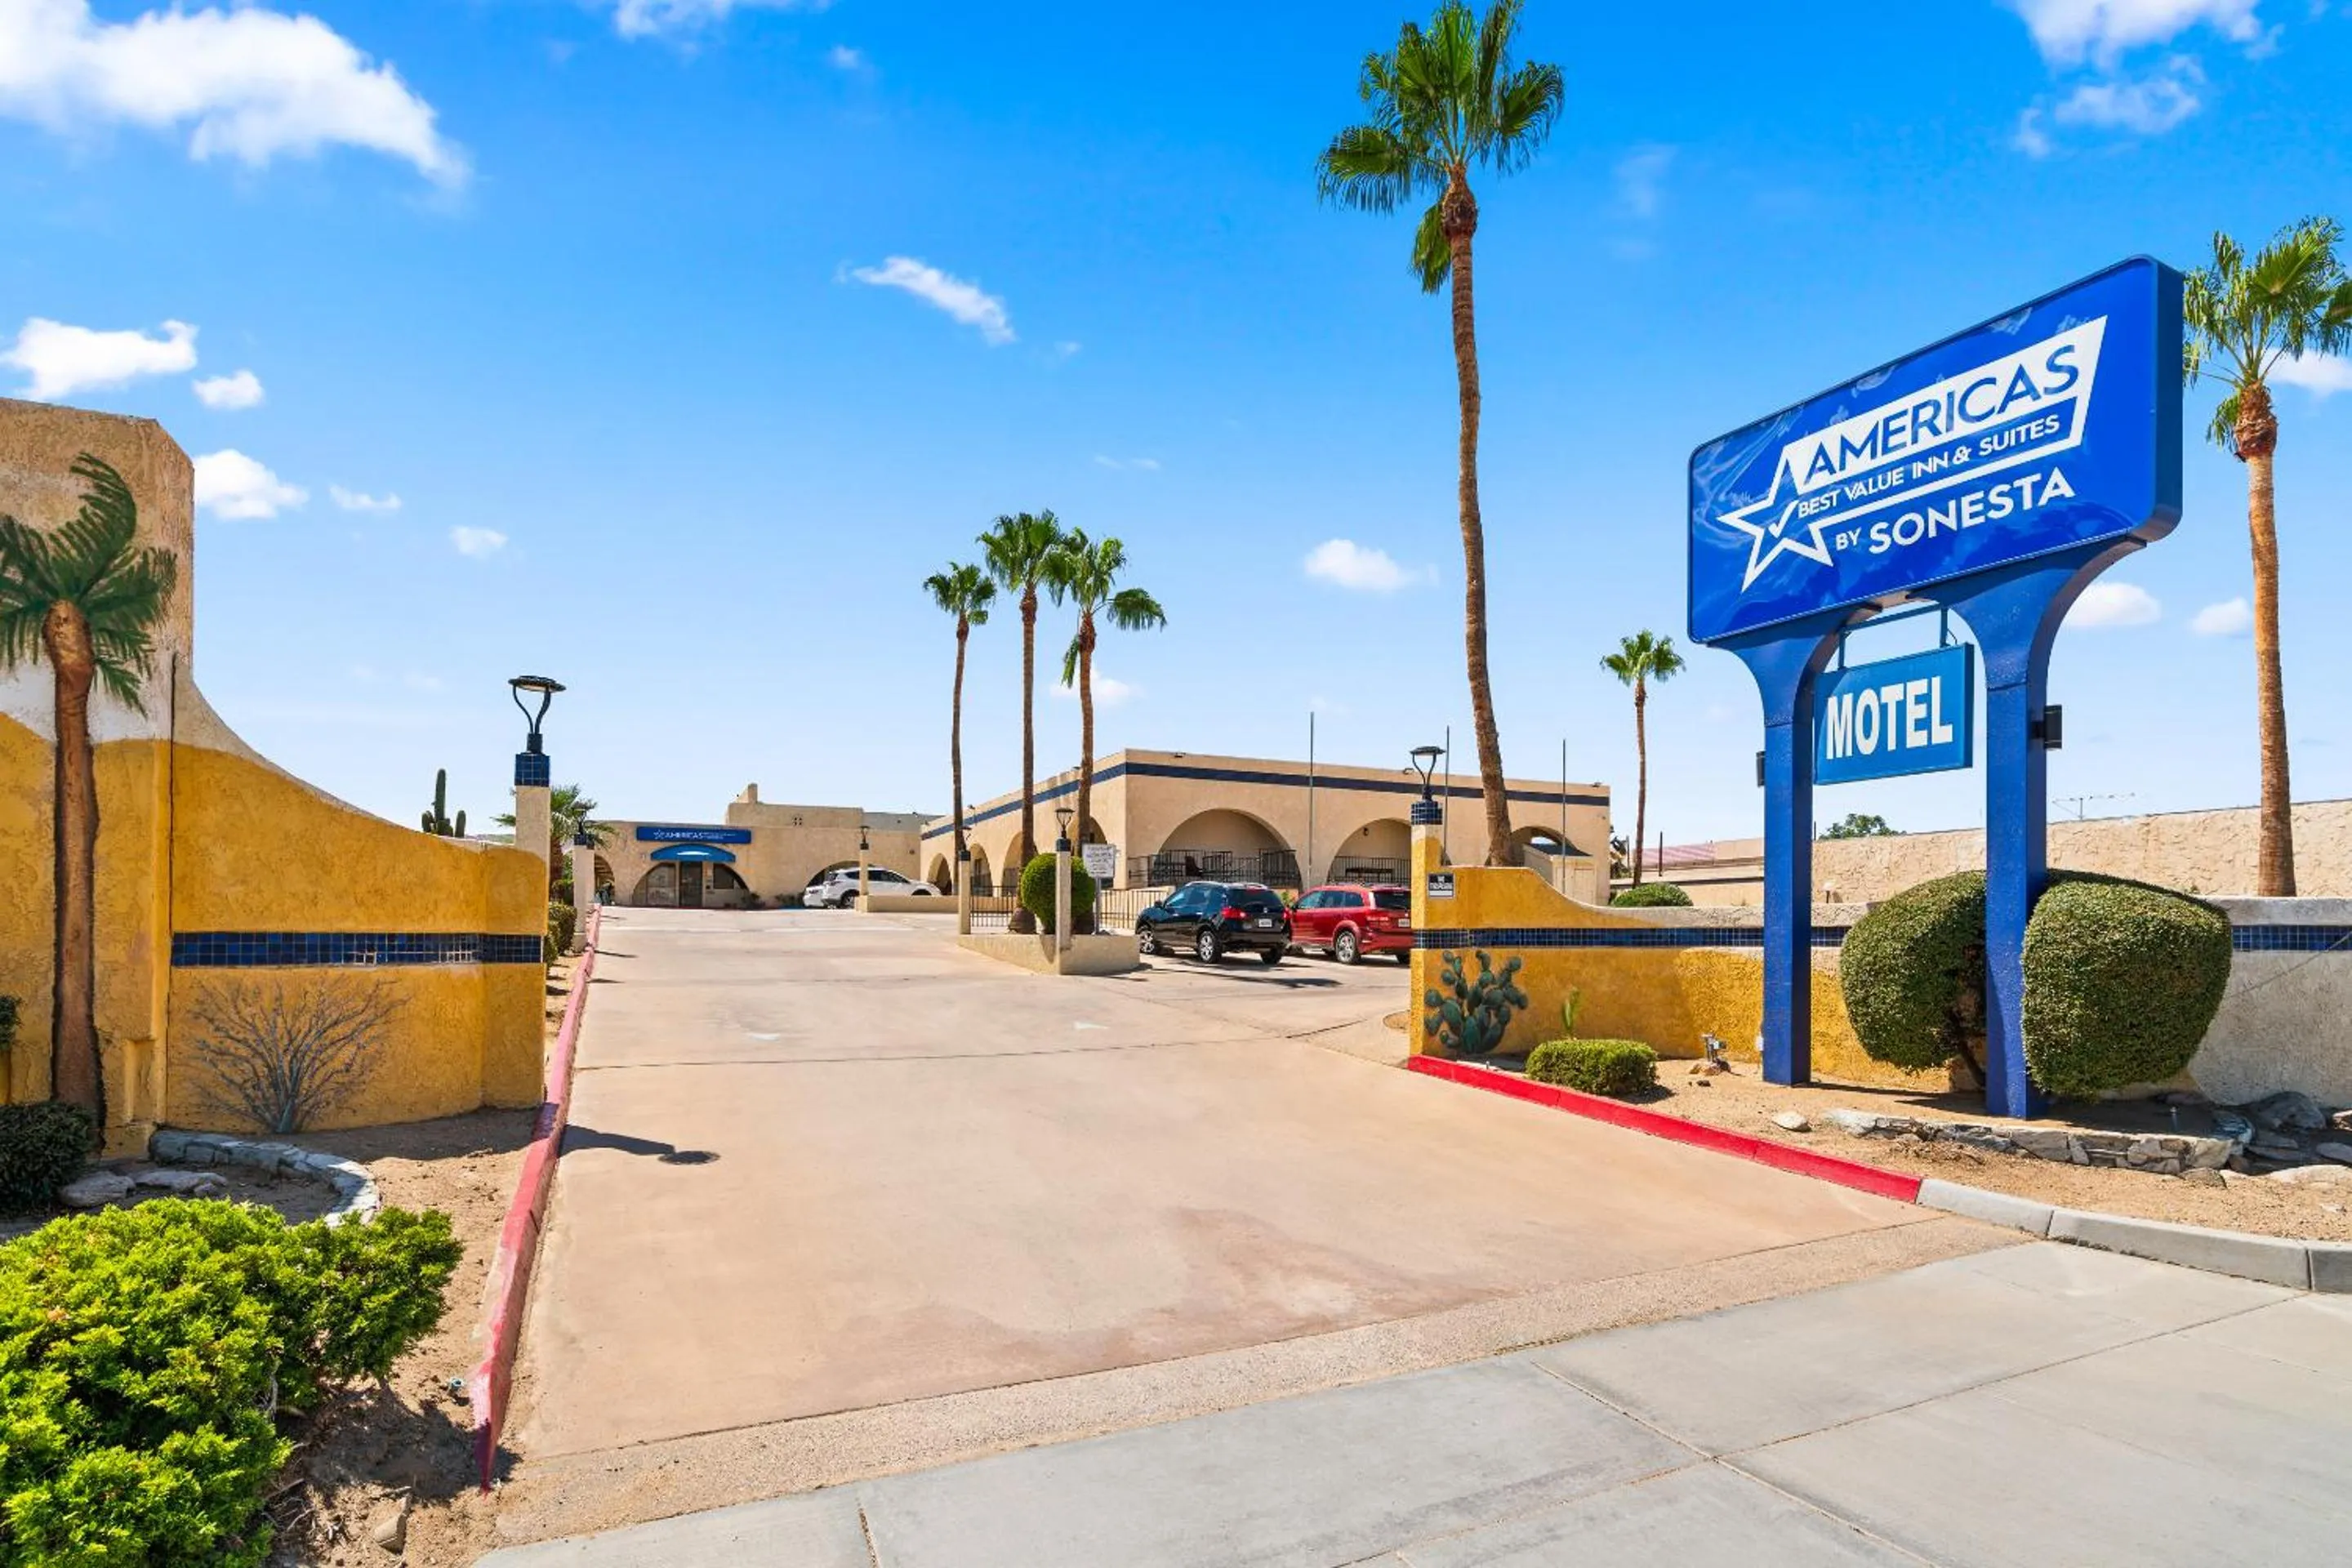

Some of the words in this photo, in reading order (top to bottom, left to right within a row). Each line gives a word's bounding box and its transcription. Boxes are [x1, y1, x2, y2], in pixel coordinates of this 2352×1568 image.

[1803, 345, 2079, 485] AMERICAS
[1797, 489, 1842, 519] BEST
[1844, 467, 1904, 501] VALUE
[1912, 452, 1949, 479] INN
[1953, 445, 1971, 465] &
[1979, 414, 2060, 456] SUITES
[1836, 527, 1862, 550] BY
[1869, 466, 2076, 555] SONESTA
[1826, 675, 1953, 760] MOTEL
